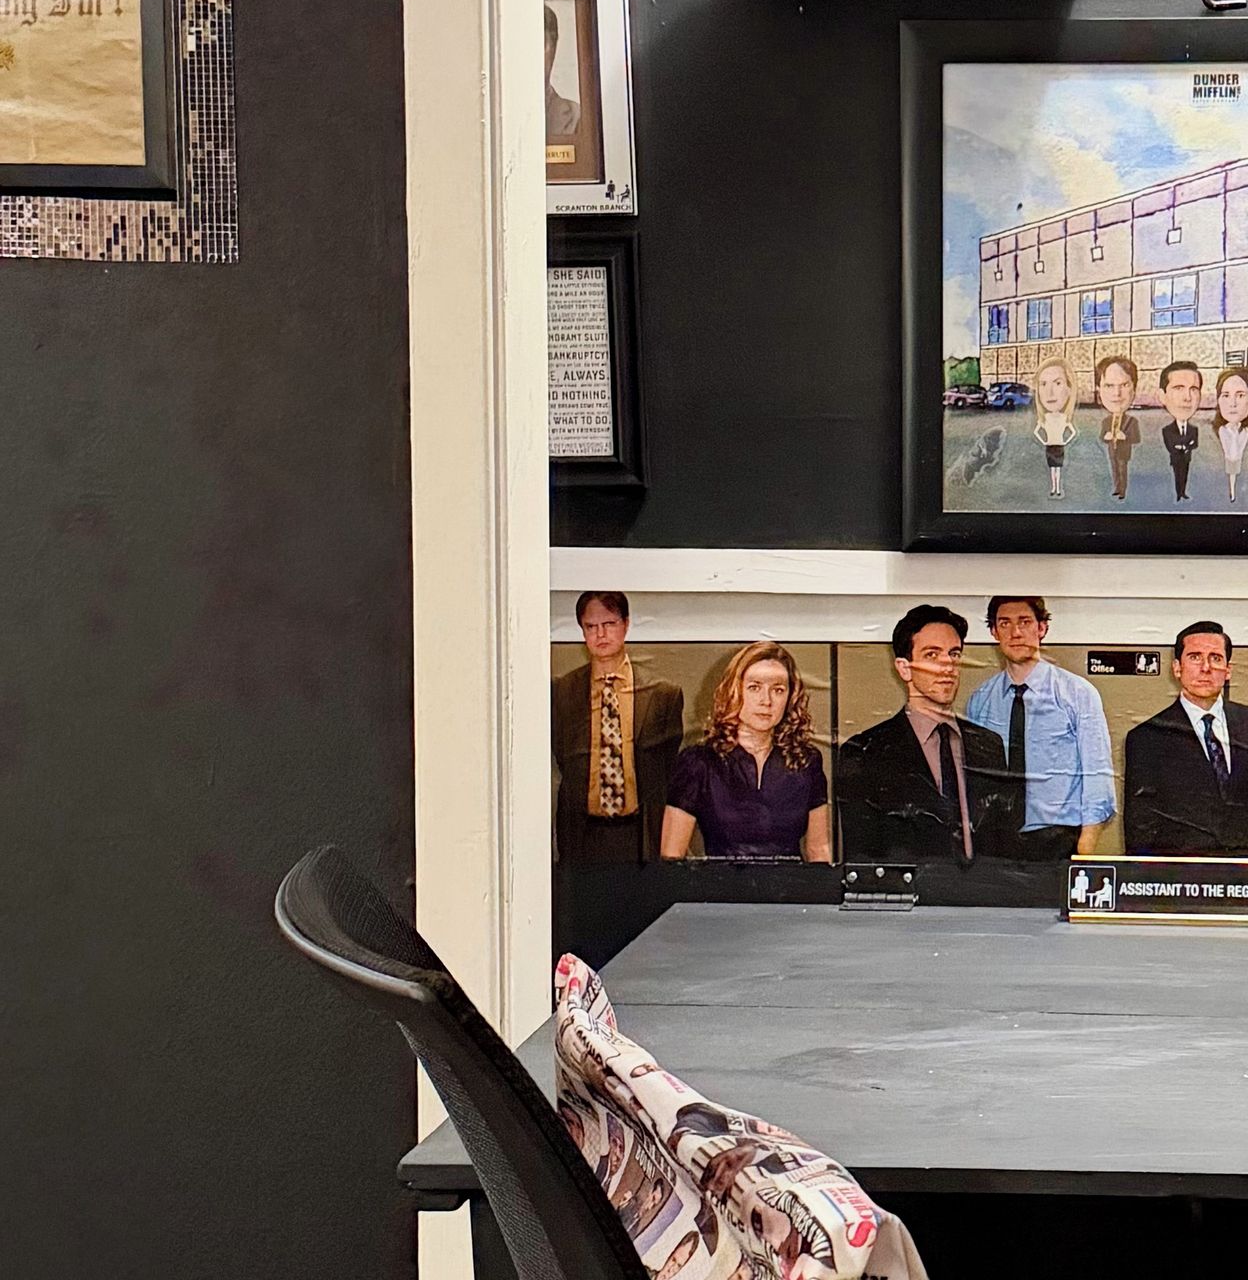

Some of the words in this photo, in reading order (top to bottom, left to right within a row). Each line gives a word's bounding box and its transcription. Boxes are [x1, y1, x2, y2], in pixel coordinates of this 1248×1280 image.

[1193, 74, 1239, 86] DUNDER
[1193, 86, 1236, 99] MIFFLIN
[555, 204, 598, 212] SCRANTON
[600, 204, 631, 212] BRANCH
[553, 269, 574, 281] SHE
[576, 269, 606, 281] SAID!
[548, 333, 582, 342] NORANT
[584, 333, 608, 341] SLUT!
[563, 369, 610, 381] ALWAYS.
[562, 390, 610, 401] NOTHING.
[553, 416, 578, 425] WHAT
[581, 416, 592, 425] TO
[1090, 664, 1115, 673] Office
[1119, 882, 1182, 897] ASSISTANT
[1184, 883, 1200, 897] TO
[1201, 884, 1224, 897] THE
